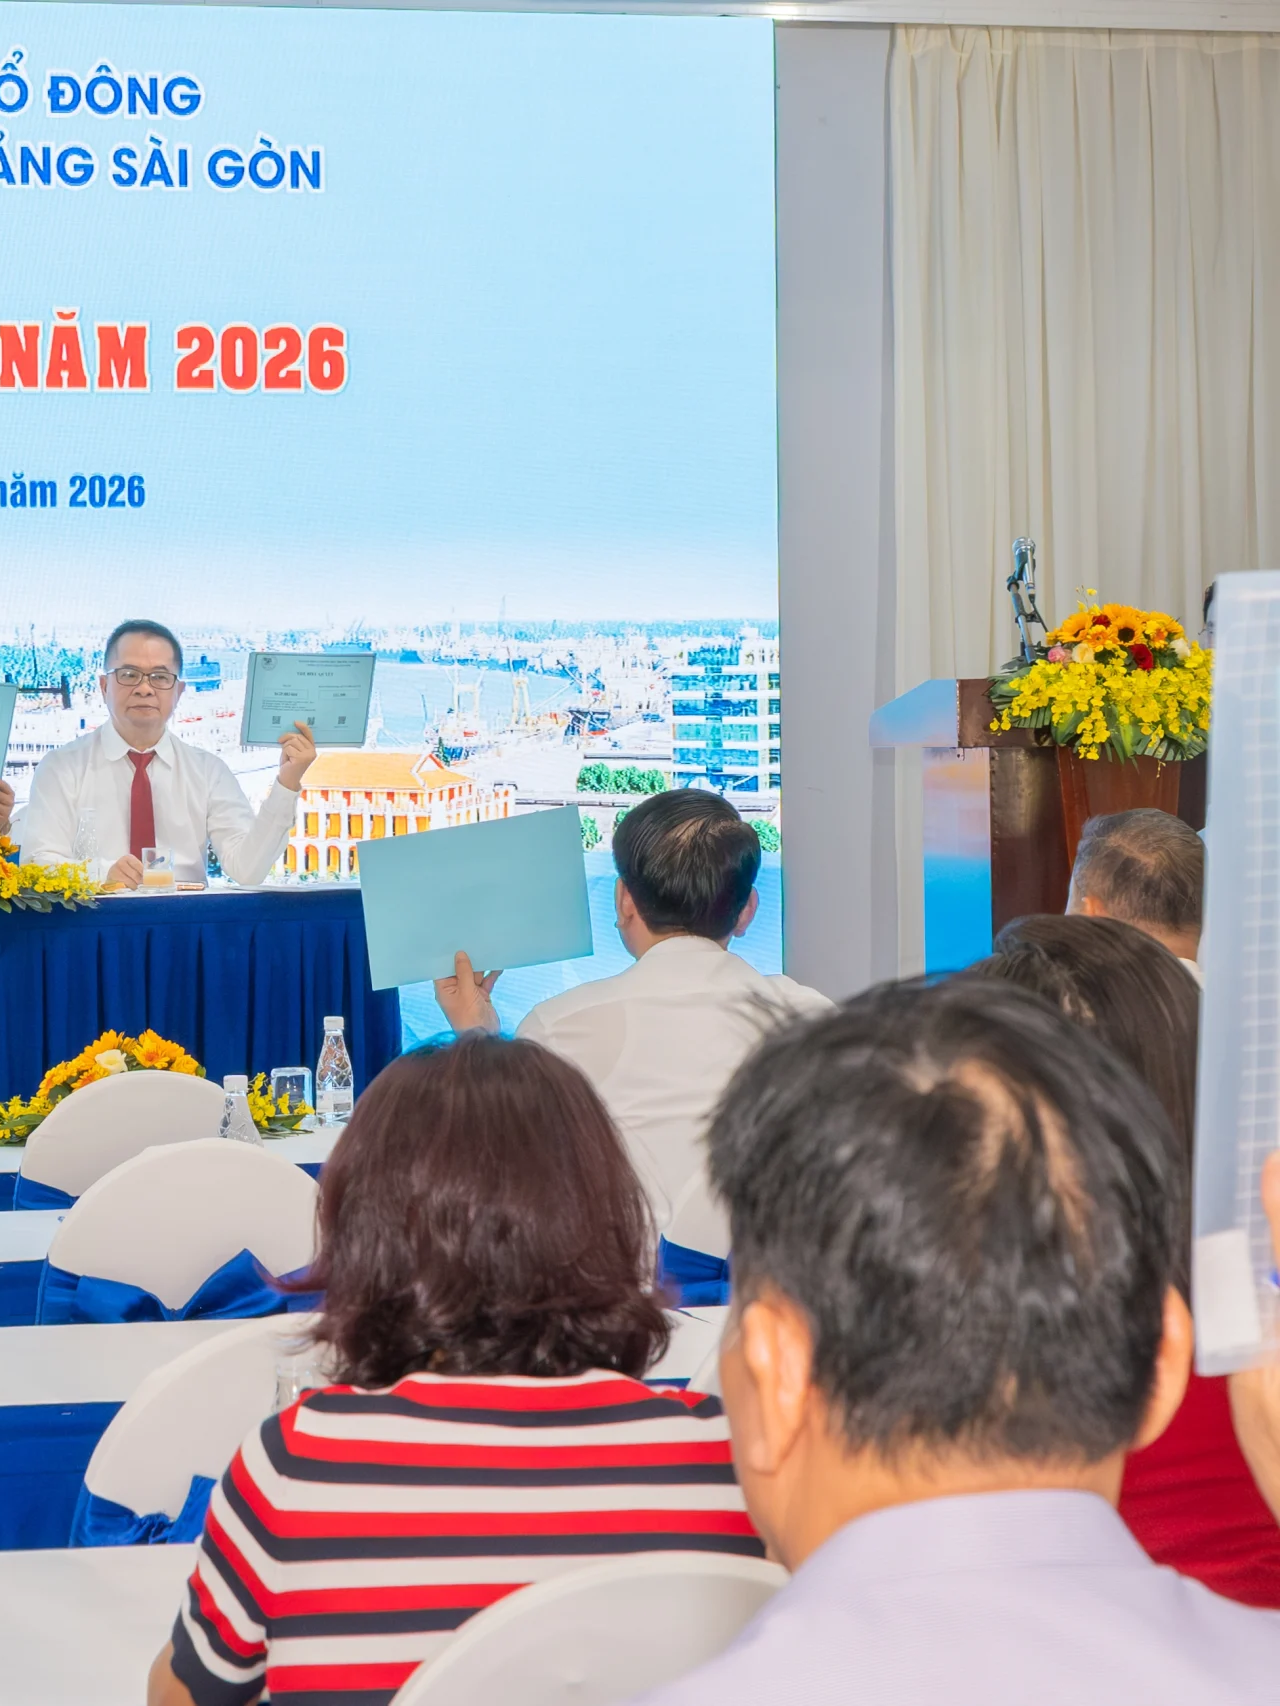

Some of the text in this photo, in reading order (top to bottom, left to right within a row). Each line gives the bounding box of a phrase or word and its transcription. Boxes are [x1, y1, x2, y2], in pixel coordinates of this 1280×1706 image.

[48, 64, 202, 116] ĐÔNG
[112, 136, 188, 188] SÀI
[207, 138, 321, 190] GÒN
[0, 310, 149, 389] NĂM
[176, 324, 346, 390] 2026
[69, 474, 145, 508] 2026
